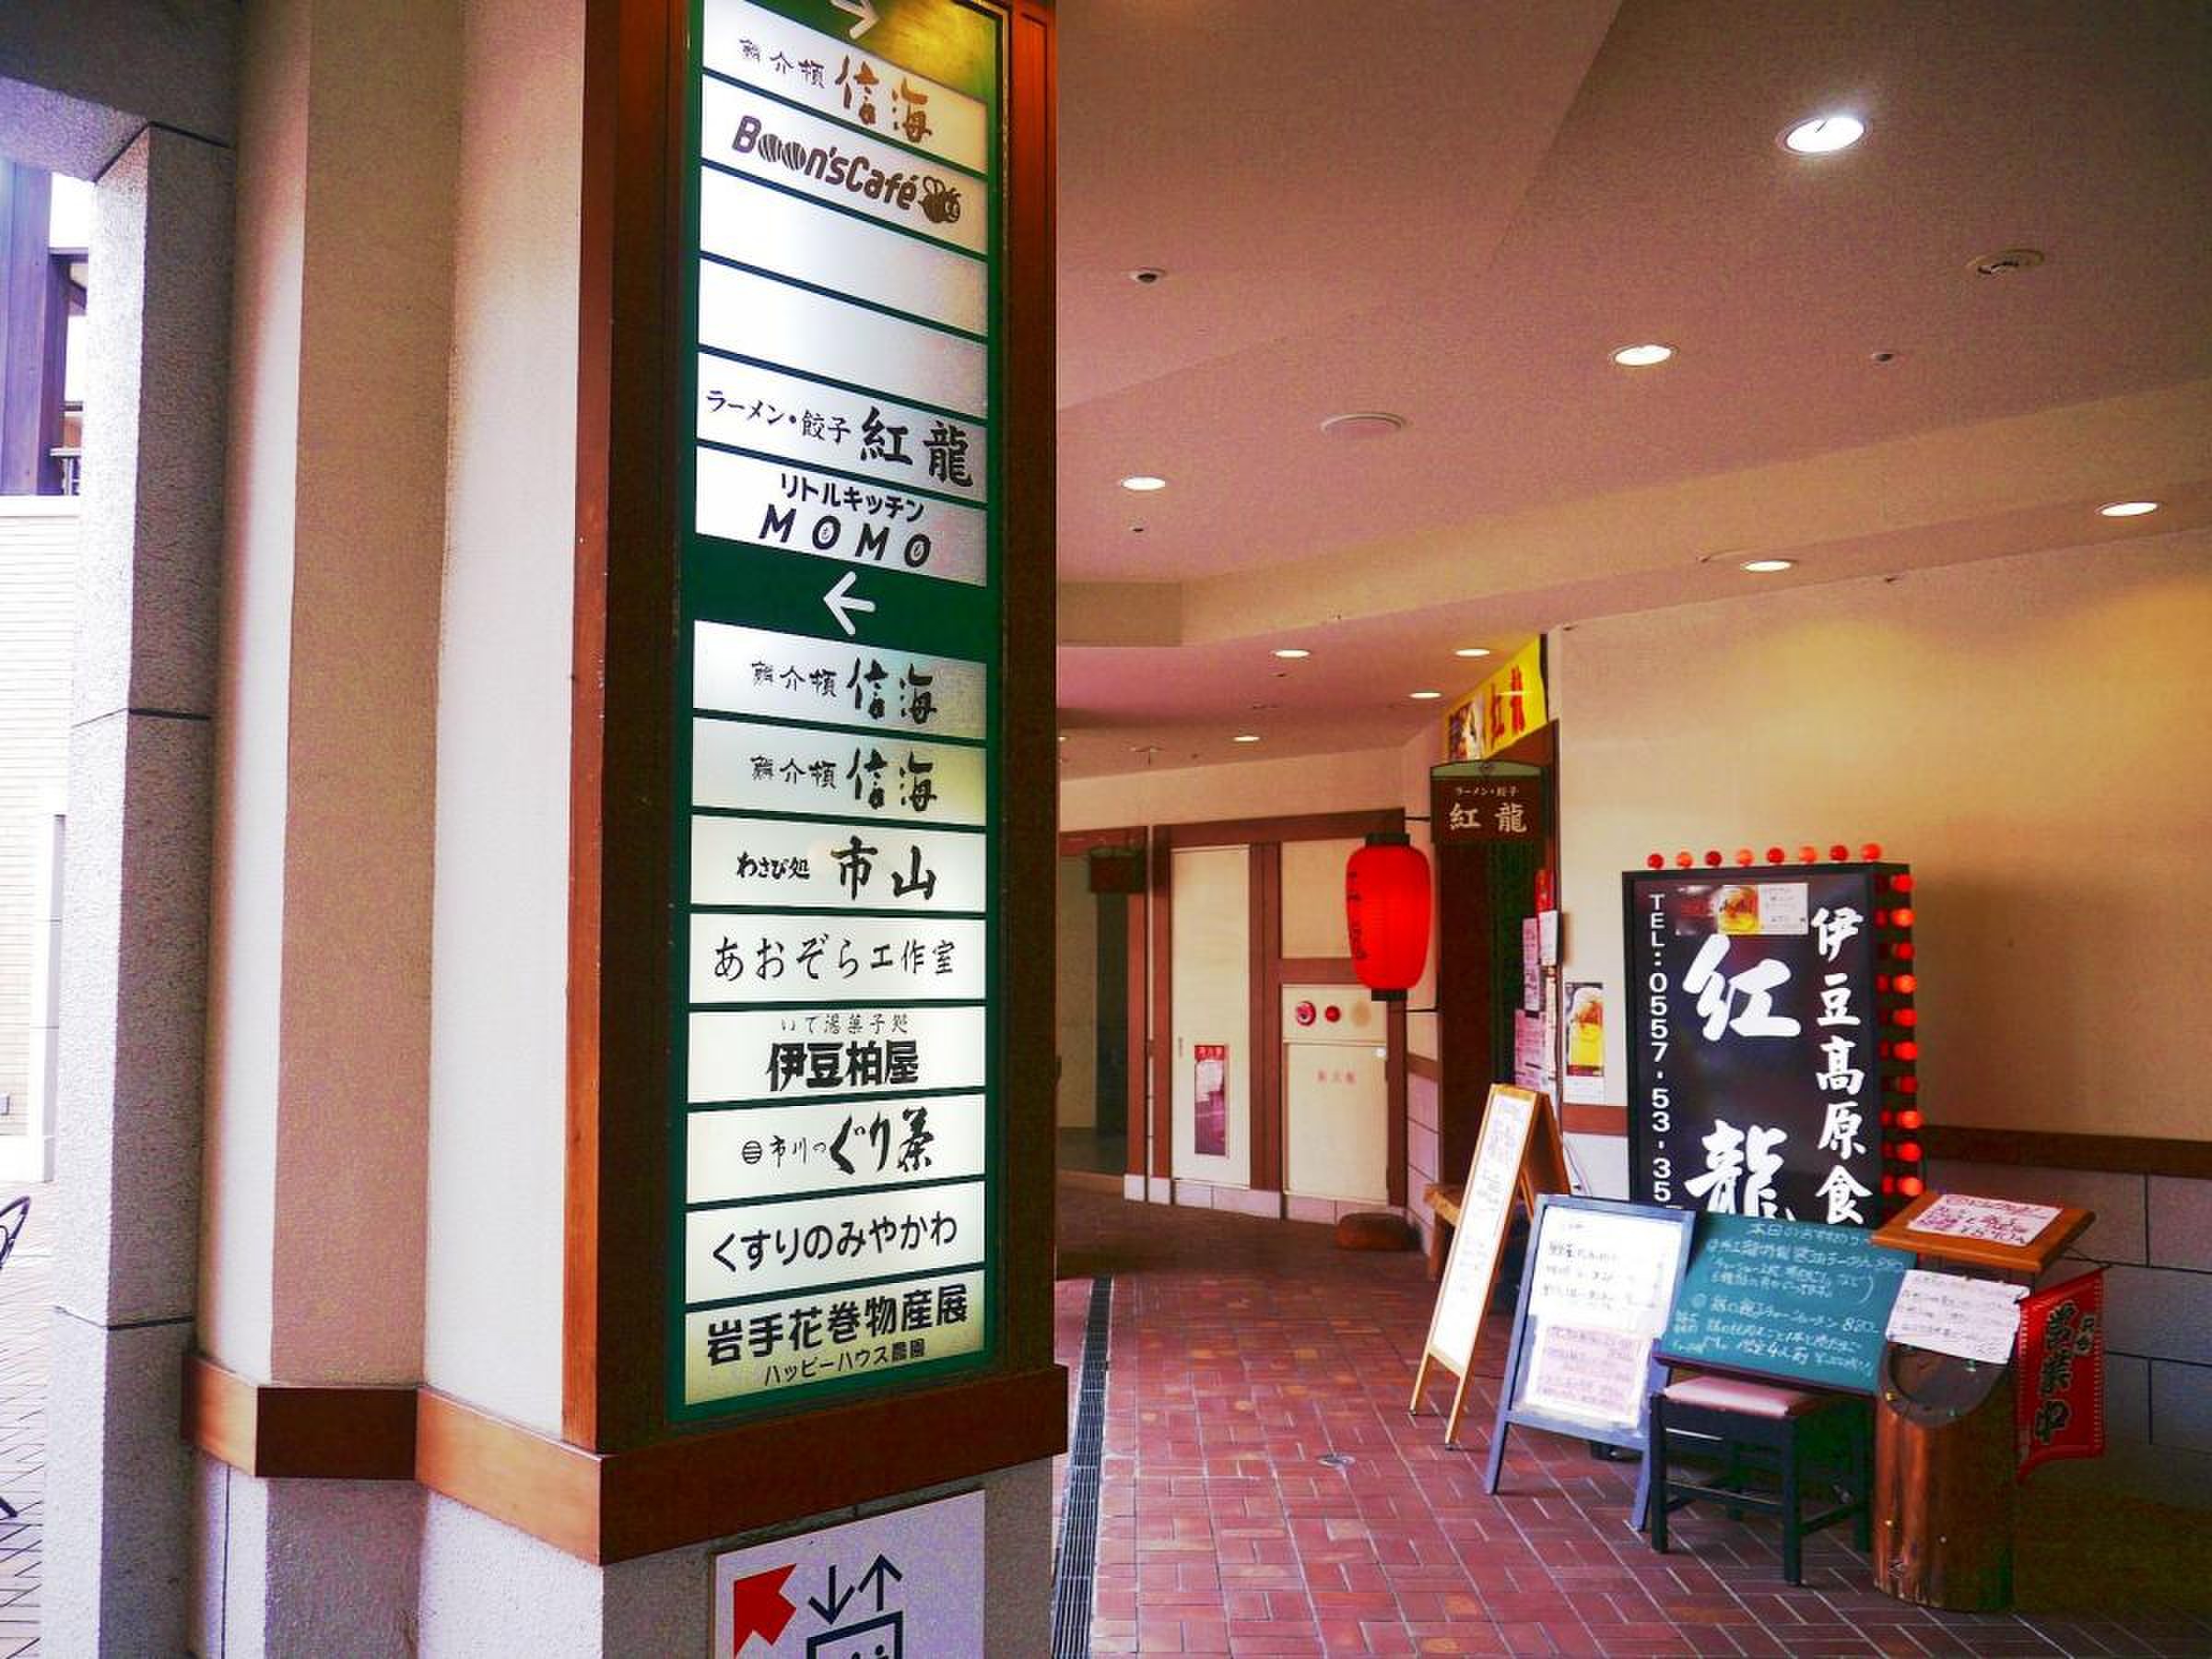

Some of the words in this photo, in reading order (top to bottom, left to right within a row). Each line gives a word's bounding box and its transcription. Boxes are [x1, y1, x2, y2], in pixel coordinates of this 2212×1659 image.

[706, 390, 852, 443] ラーメン・餃子
[860, 406, 974, 488] 紅龍
[781, 473, 924, 523] リトルキッチン
[759, 503, 932, 568] MOMO
[846, 657, 937, 724] 信海
[846, 747, 937, 812] 信海
[1449, 802, 1527, 833] 紅龍
[736, 851, 811, 880] わさび処
[830, 835, 937, 900] 市山
[713, 933, 957, 982] あおぞら工作室
[767, 1040, 919, 1092] 伊豆柏屋
[1811, 906, 1873, 1225] 伊豆高原食
[712, 1210, 959, 1272] くすりのみやかわ
[707, 1283, 969, 1366] 岩手花巻物産展
